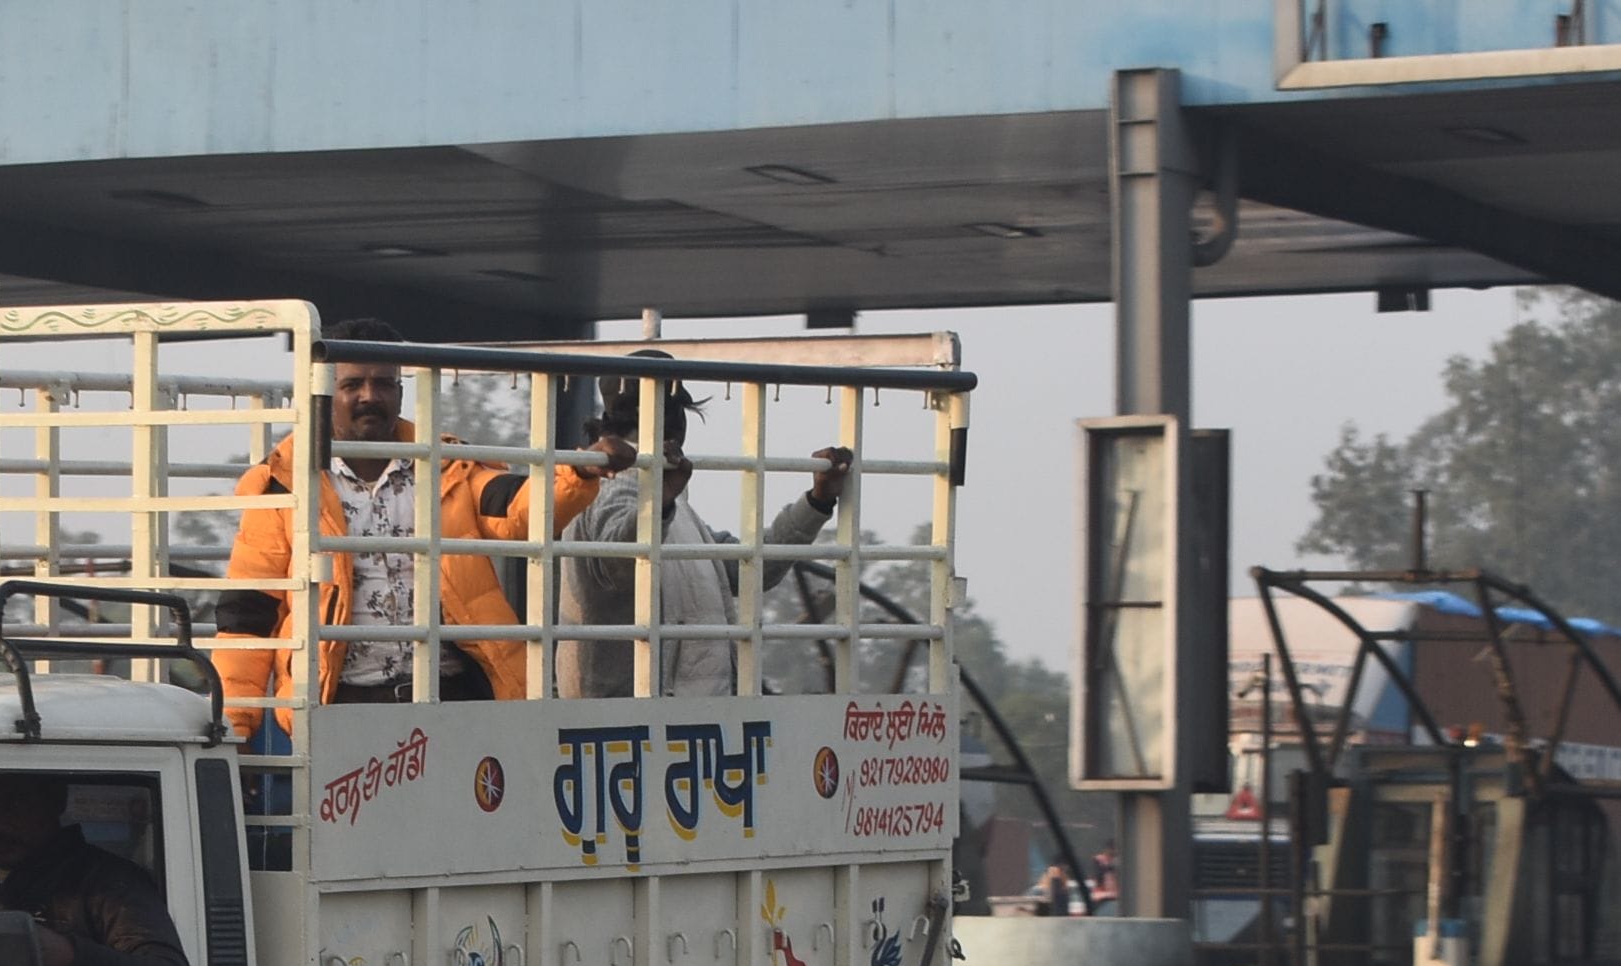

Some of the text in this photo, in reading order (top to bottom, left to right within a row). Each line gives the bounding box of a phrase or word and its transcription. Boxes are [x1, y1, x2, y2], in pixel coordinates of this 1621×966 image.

[320, 727, 428, 827] ਕਰਨ ਦੀ ਗੱਡੀ
[664, 720, 774, 843] ਰਾਖਾ
[859, 755, 950, 788] 9217928980
[853, 801, 945, 838] 9814125794
